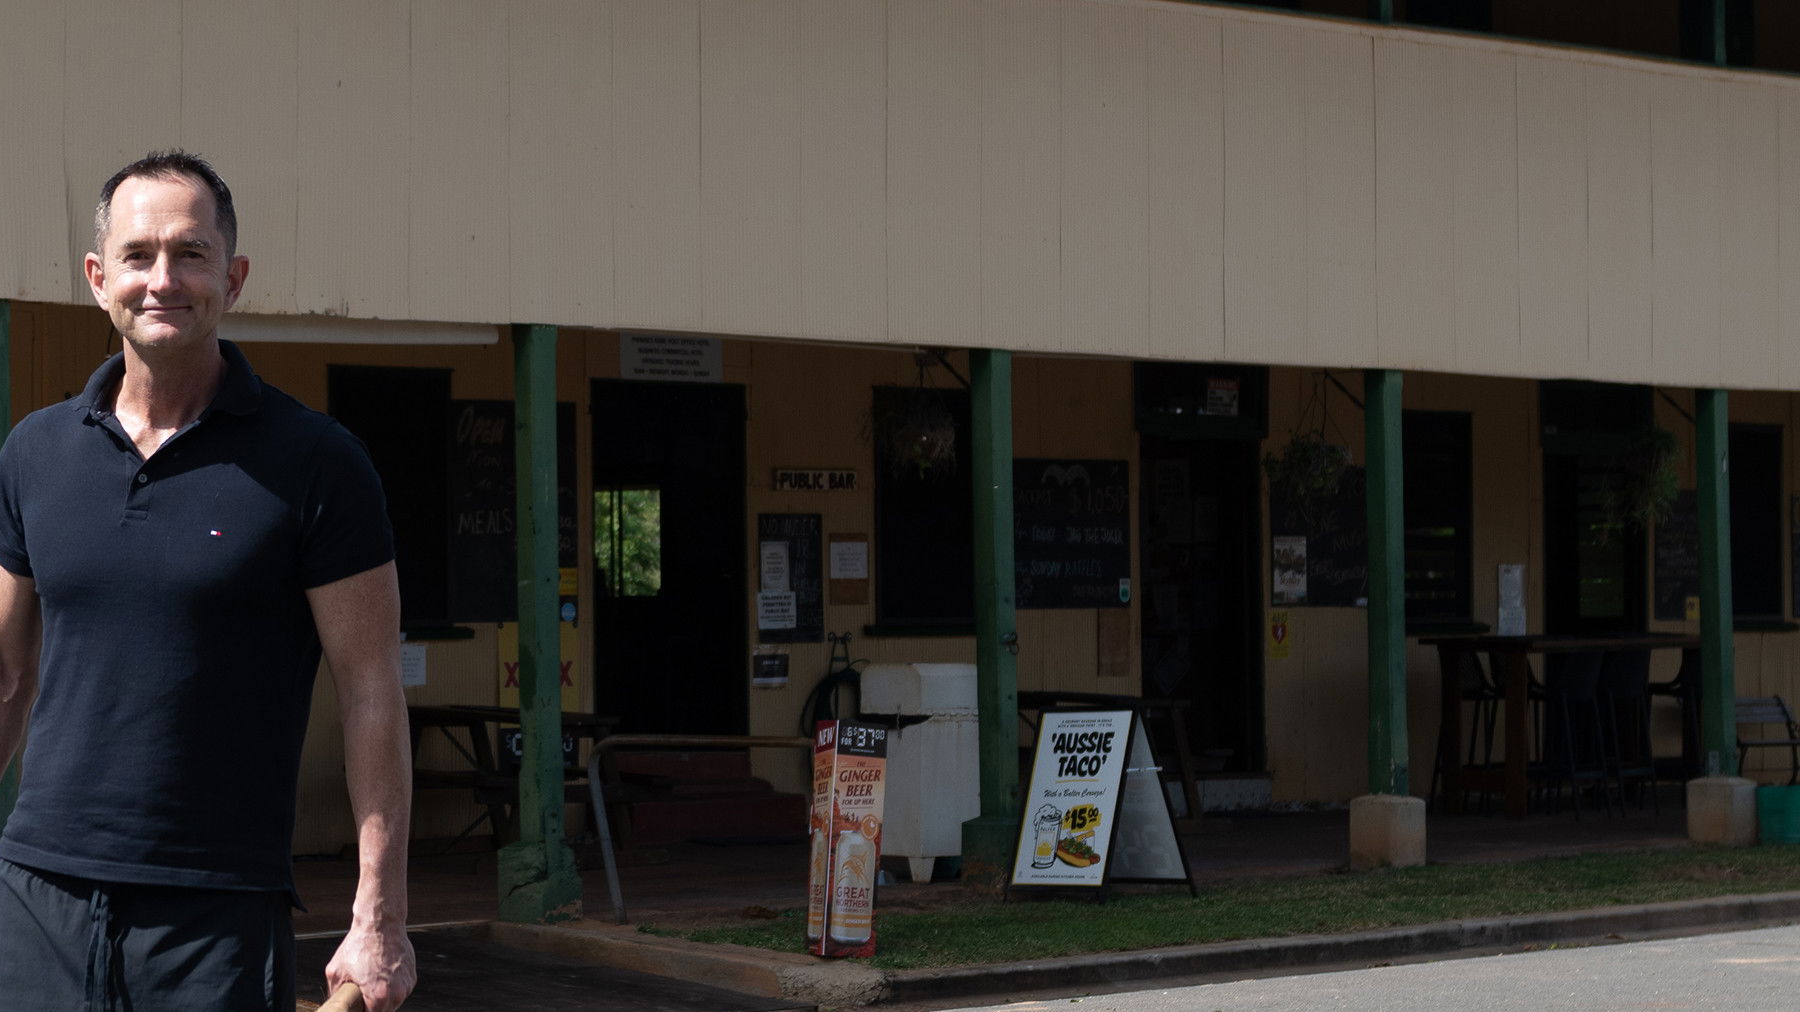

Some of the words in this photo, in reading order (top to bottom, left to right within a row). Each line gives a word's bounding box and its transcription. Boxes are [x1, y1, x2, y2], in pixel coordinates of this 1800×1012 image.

[780, 472, 824, 489] PUBLIC
[828, 472, 856, 489] BAR
[457, 506, 514, 536] MEALS
[817, 727, 836, 748] NEW
[841, 737, 852, 746] FOR
[1052, 731, 1115, 754] 'AUSSIE
[1058, 754, 1106, 777] TACO'
[839, 769, 882, 783] GINGER
[846, 784, 873, 797] BEER
[836, 886, 871, 899] GREAT
